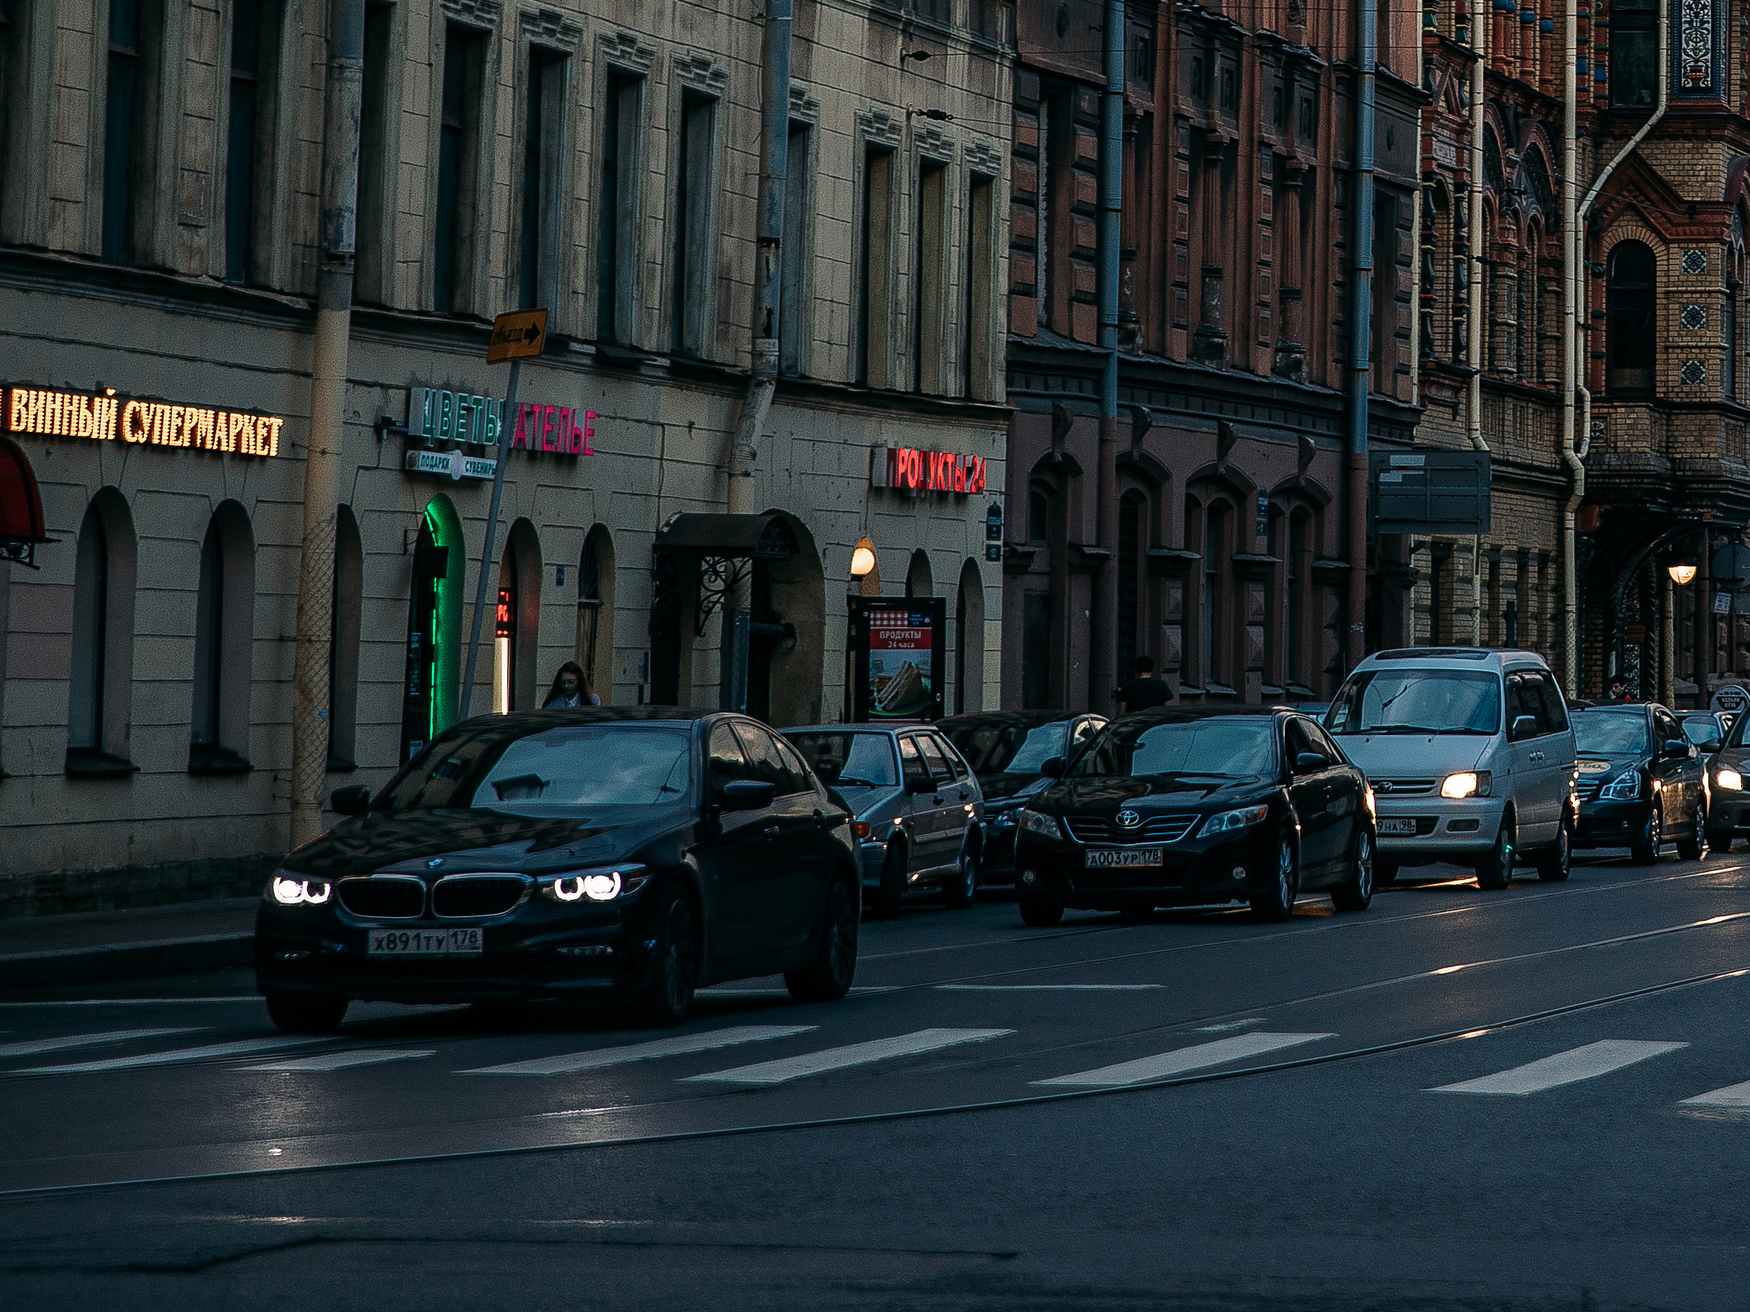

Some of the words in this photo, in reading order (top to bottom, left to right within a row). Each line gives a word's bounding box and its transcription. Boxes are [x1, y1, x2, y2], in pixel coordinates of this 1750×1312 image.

[9, 387, 119, 440] ВИННЫЙ
[122, 399, 284, 457] СУПЕРМАРКЕТ
[421, 387, 505, 447] ЦВЕТЫ
[513, 402, 598, 456] АТЕЛЬЕ
[421, 454, 451, 470] ПОДАРКИ
[885, 447, 967, 498] ПРОДУКТЫ
[969, 454, 987, 495] 24
[879, 630, 922, 640] ПРОДУКТЫ
[888, 640, 898, 648] 24
[1401, 819, 1413, 829] 98
[1141, 850, 1159, 861] 178
[374, 931, 447, 951] Х891ТУ
[450, 929, 478, 945] 178
